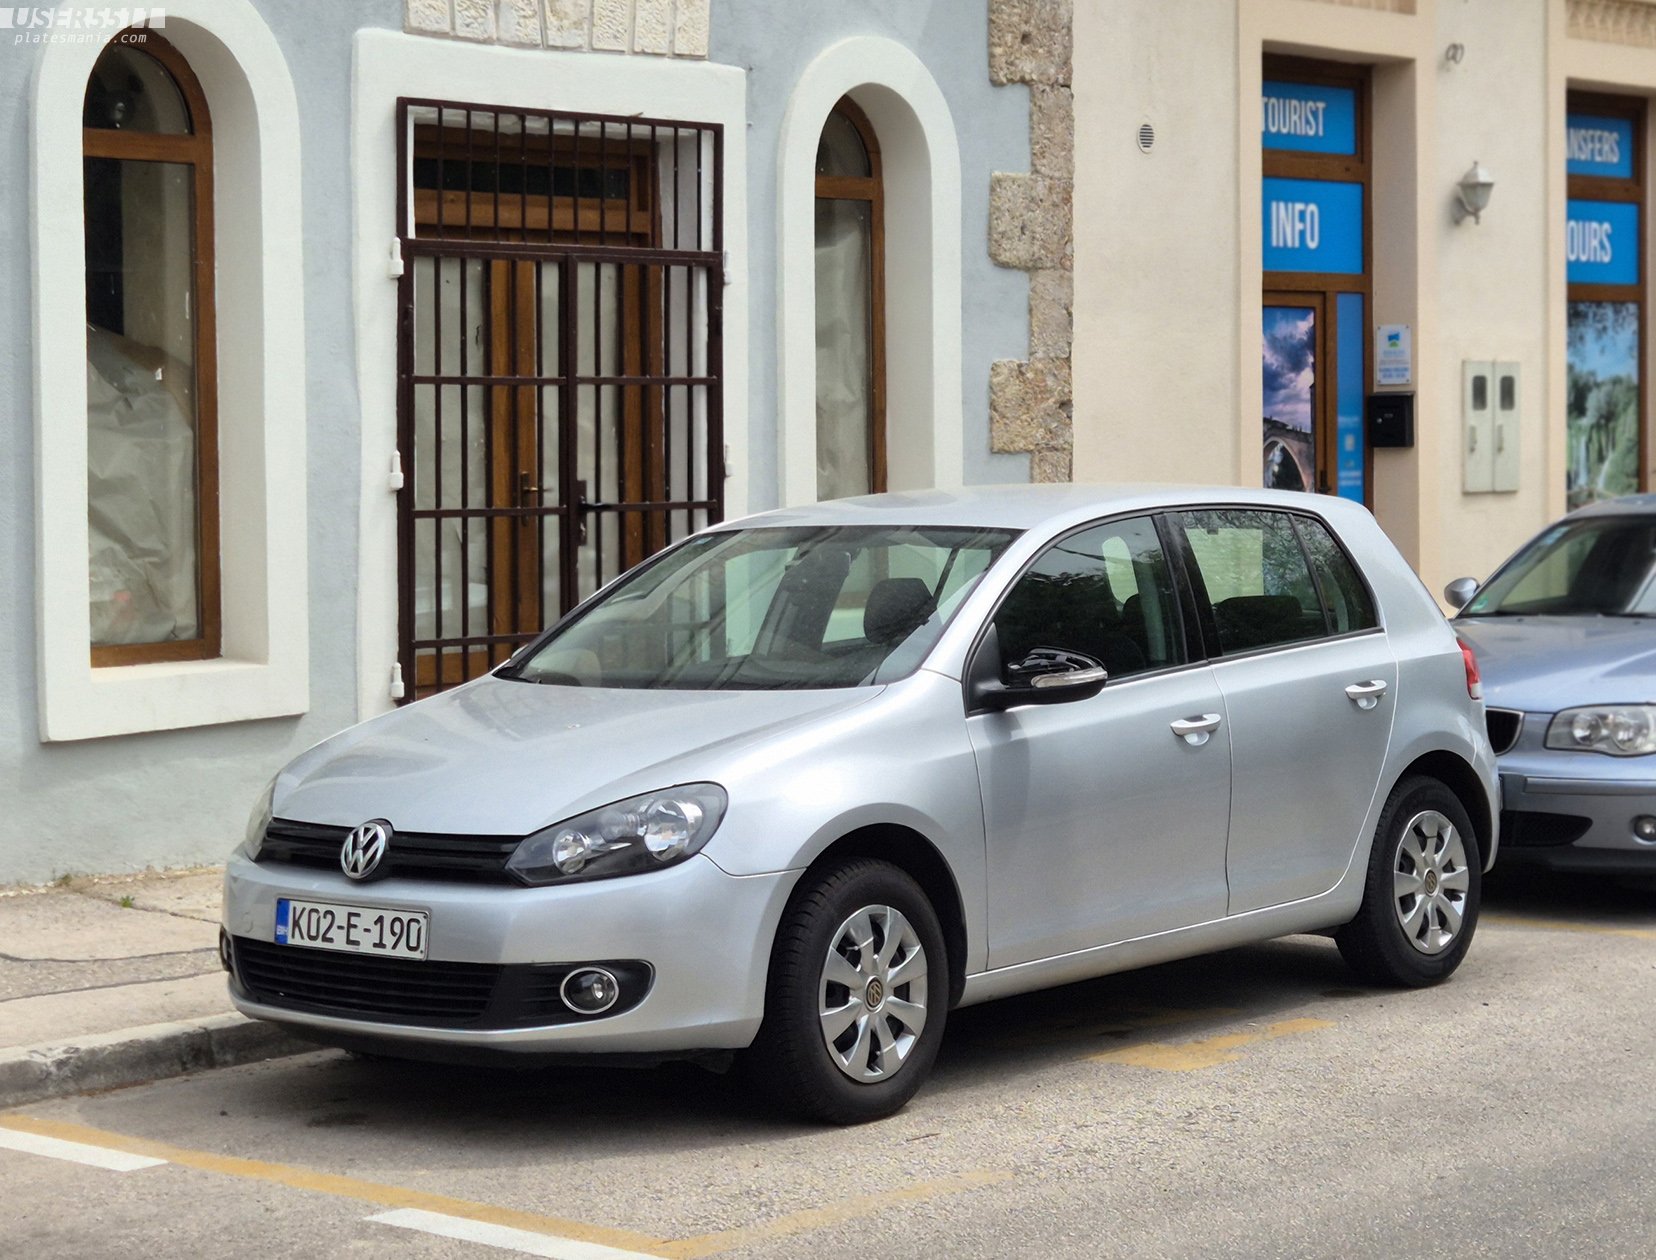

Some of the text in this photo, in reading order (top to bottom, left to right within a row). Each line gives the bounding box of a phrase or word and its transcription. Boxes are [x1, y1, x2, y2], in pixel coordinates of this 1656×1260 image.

[1262, 96, 1326, 137] TOURIST
[1567, 127, 1620, 164] NSFERS
[1271, 201, 1319, 249] INFO
[291, 906, 422, 952] K02-E-190
